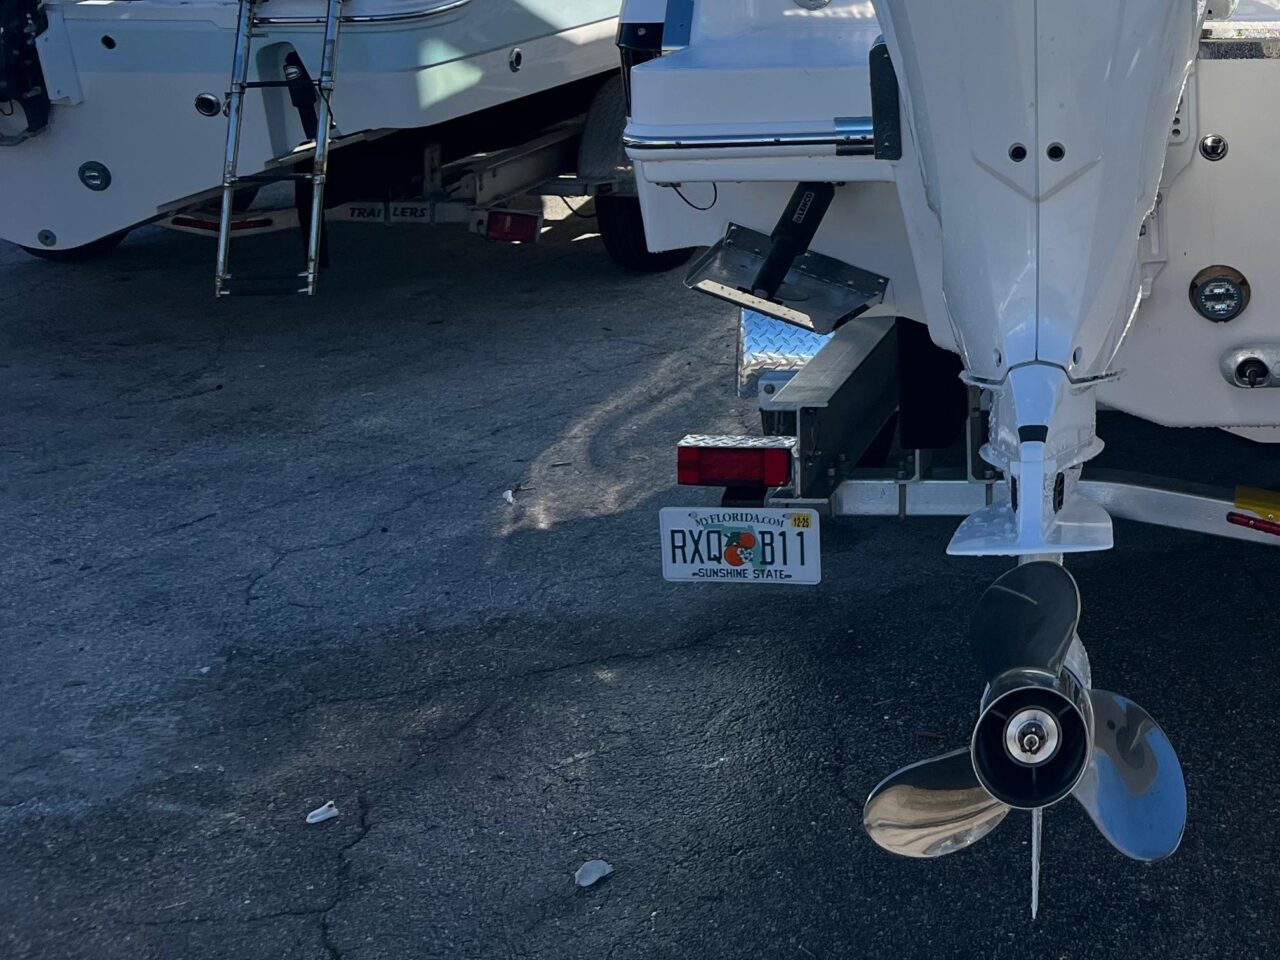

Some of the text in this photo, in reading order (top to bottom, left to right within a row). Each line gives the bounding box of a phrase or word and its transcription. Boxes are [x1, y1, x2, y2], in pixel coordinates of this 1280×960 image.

[670, 529, 806, 566] RXQ B11
[698, 567, 786, 580] SUNSHINE STATE
